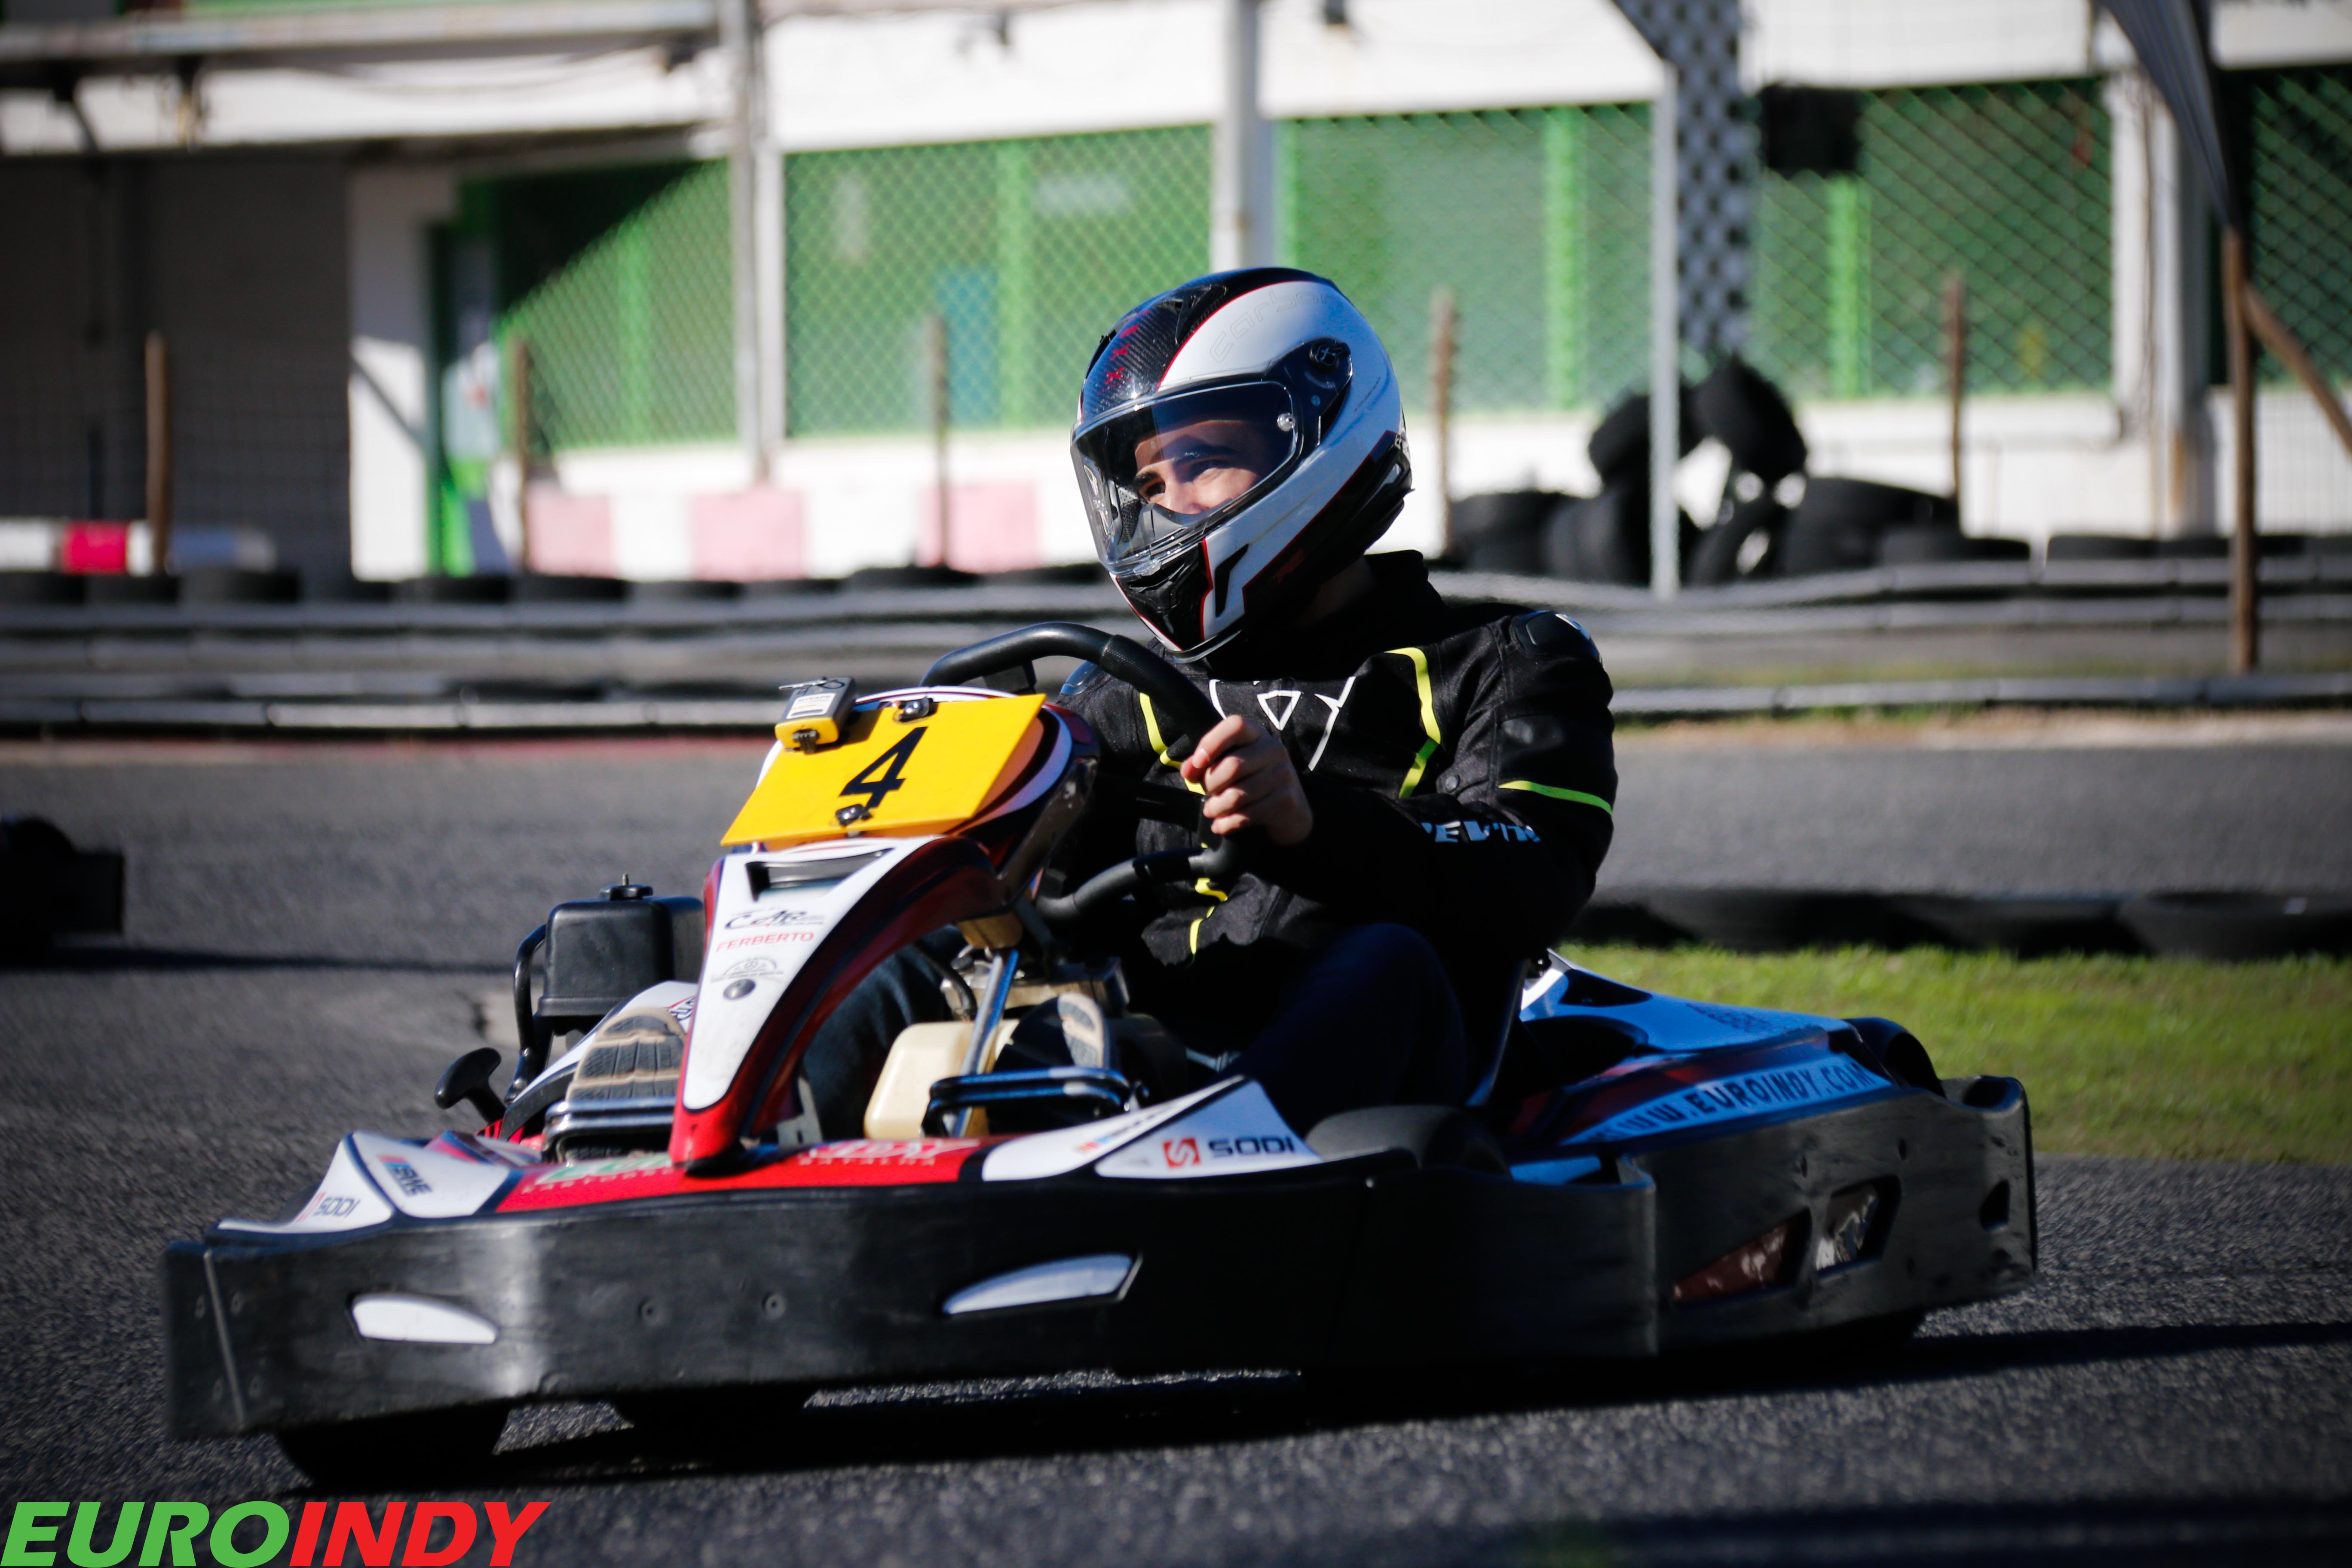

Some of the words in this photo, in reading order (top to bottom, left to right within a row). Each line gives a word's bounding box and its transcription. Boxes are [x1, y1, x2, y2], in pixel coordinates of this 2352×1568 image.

[839, 726, 928, 810] 4
[716, 931, 815, 952] FERBERTO
[1208, 1137, 1295, 1158] SODI
